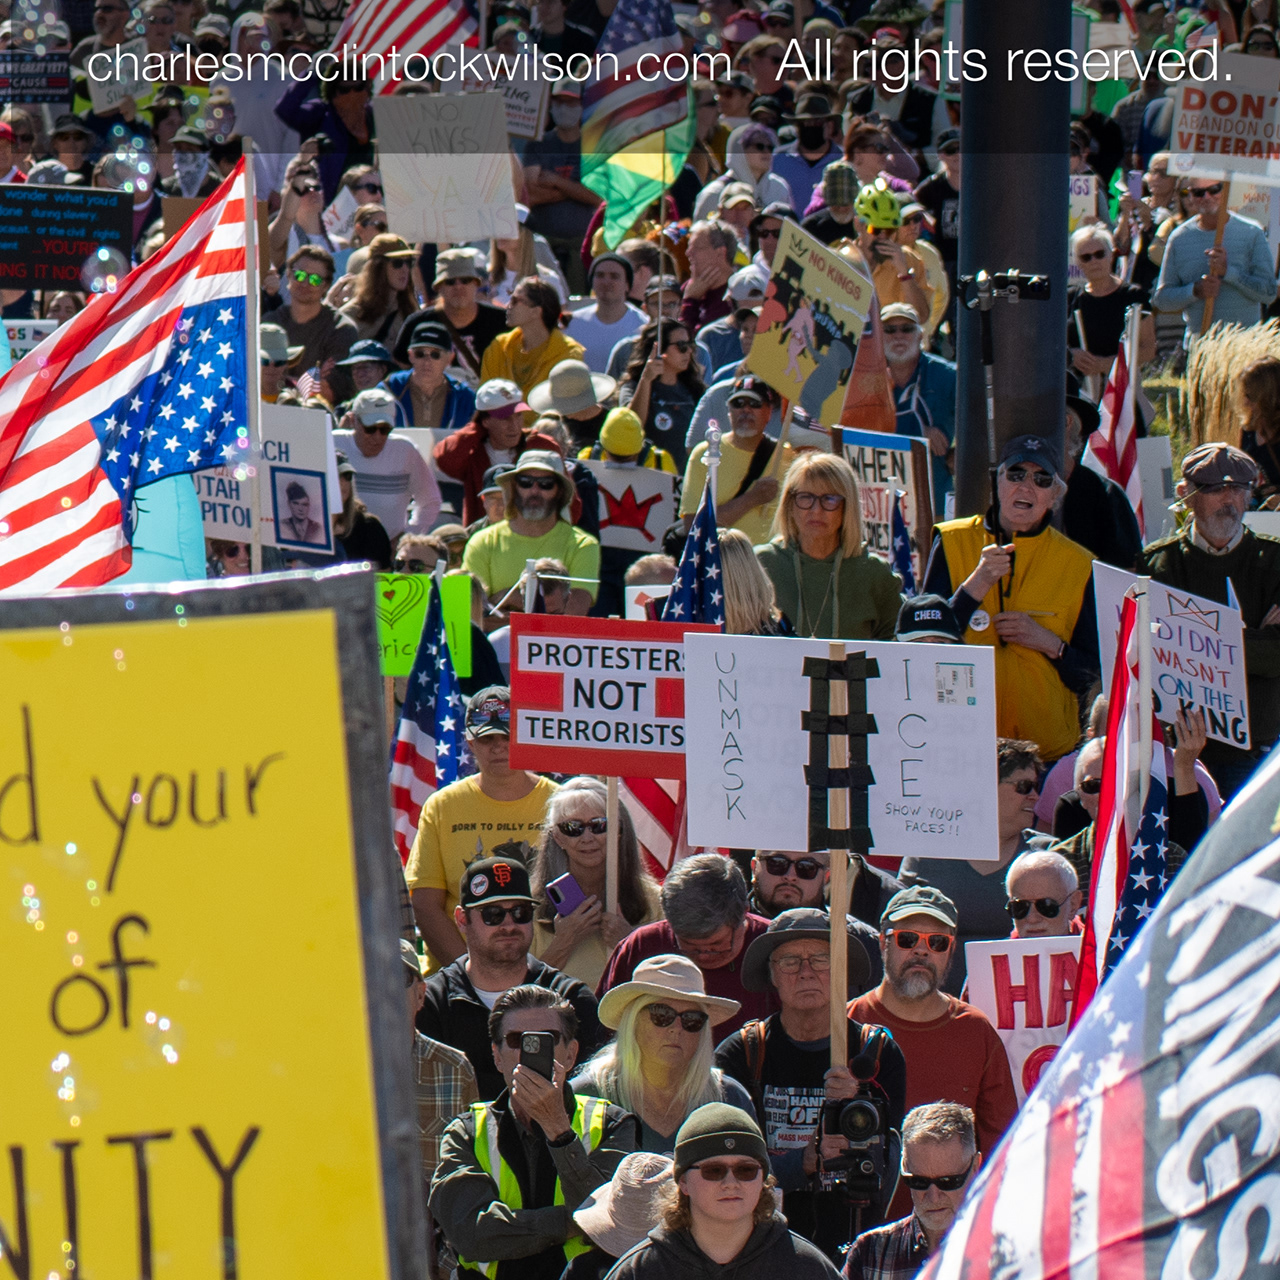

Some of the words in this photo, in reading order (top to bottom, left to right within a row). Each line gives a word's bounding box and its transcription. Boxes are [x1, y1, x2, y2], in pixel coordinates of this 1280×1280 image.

[1177, 113, 1259, 137] ABANDON
[4, 188, 50, 200] wonder
[54, 191, 84, 202] what
[36, 227, 47, 235] or
[62, 226, 86, 237] civil
[93, 228, 120, 241] rights
[34, 262, 48, 278] IT
[807, 249, 827, 270] NO
[826, 265, 862, 300] KINGS
[843, 445, 906, 486] WHEN
[914, 609, 942, 622] CHEER
[1156, 618, 1238, 667] DIDN'T
[1152, 646, 1231, 690] WASN'T
[573, 677, 647, 712] NOT
[1159, 674, 1193, 701] ON
[1199, 684, 1235, 712] THE
[525, 716, 685, 746] TERRORISTS
[714, 651, 747, 821] UNMASK
[897, 658, 927, 798] ICE
[92, 752, 288, 892] your
[451, 822, 477, 834] BORN
[480, 822, 493, 833] TO
[496, 821, 523, 832] DILLY
[884, 803, 921, 817] SHOW
[904, 820, 961, 837] FACES!!
[49, 913, 156, 1038] of
